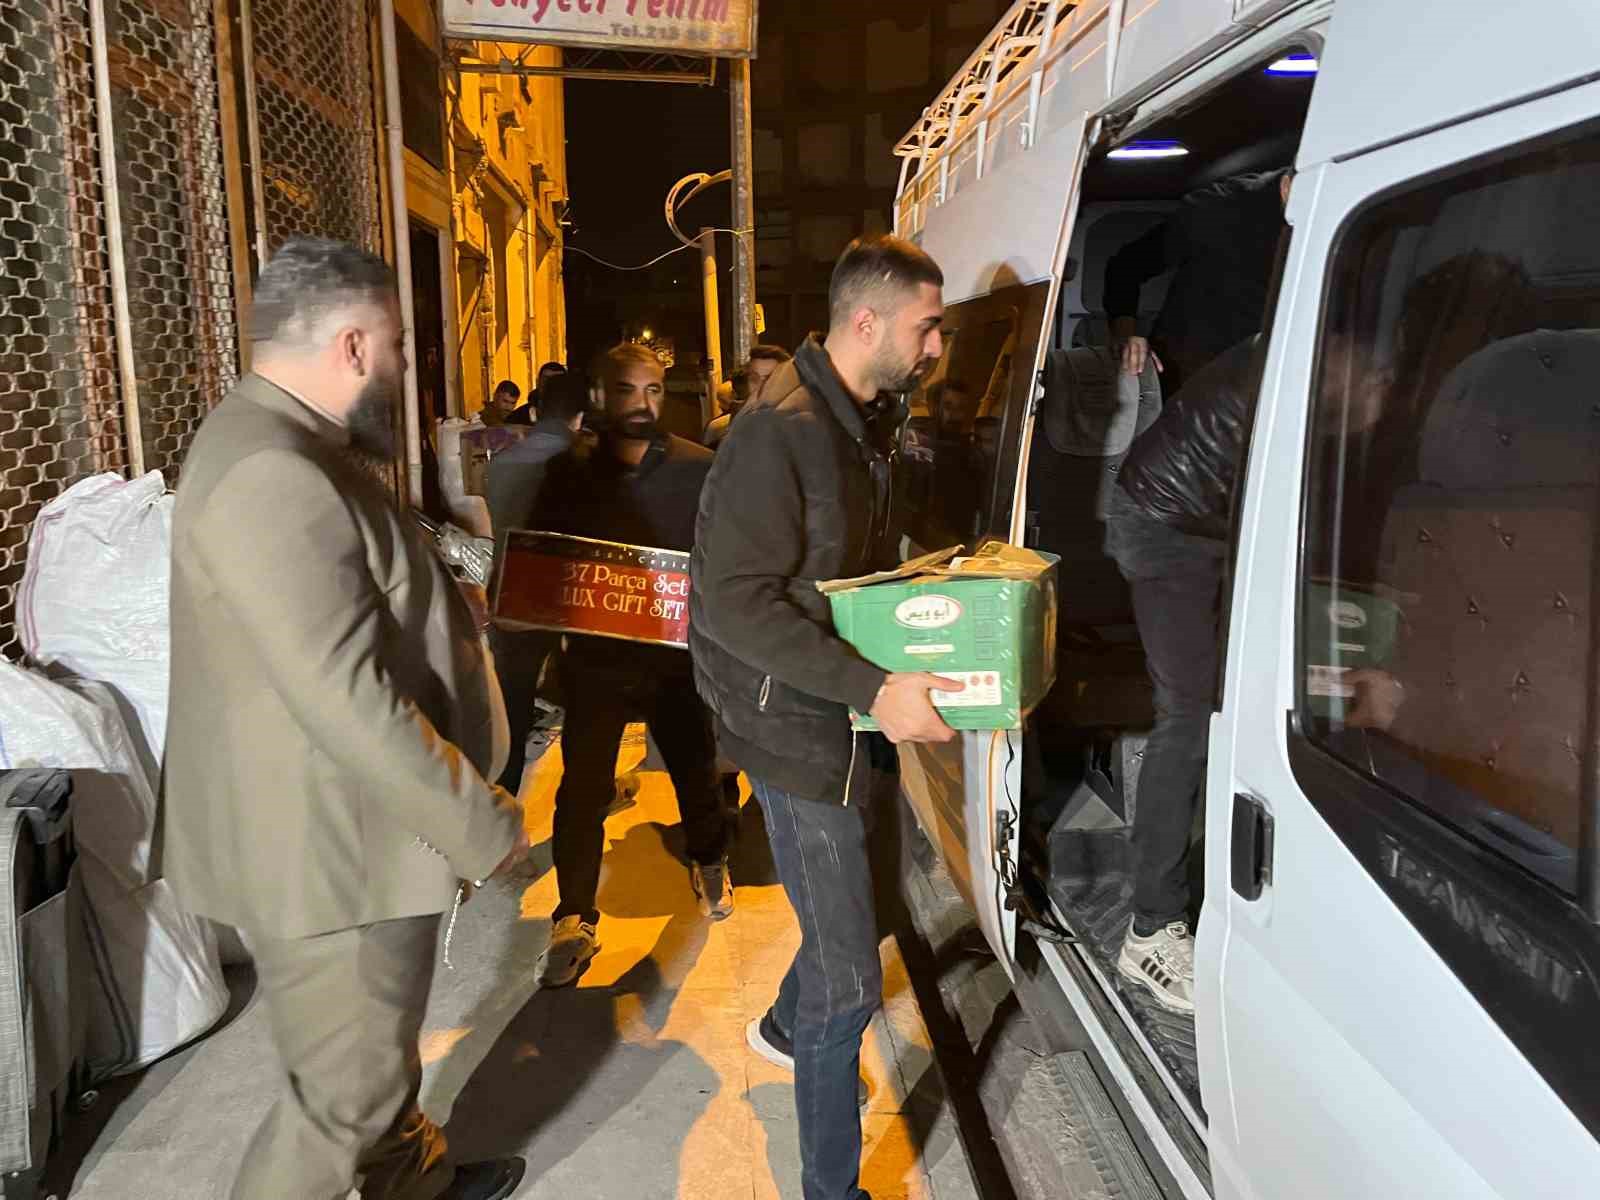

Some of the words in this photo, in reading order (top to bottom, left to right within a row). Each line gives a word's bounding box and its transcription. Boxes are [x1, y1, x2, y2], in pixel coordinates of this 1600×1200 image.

[593, 564, 646, 593] Parça
[653, 573, 688, 596] Set
[562, 585, 596, 608] LUX
[602, 592, 647, 615] GIFT
[649, 599, 685, 620] SET
